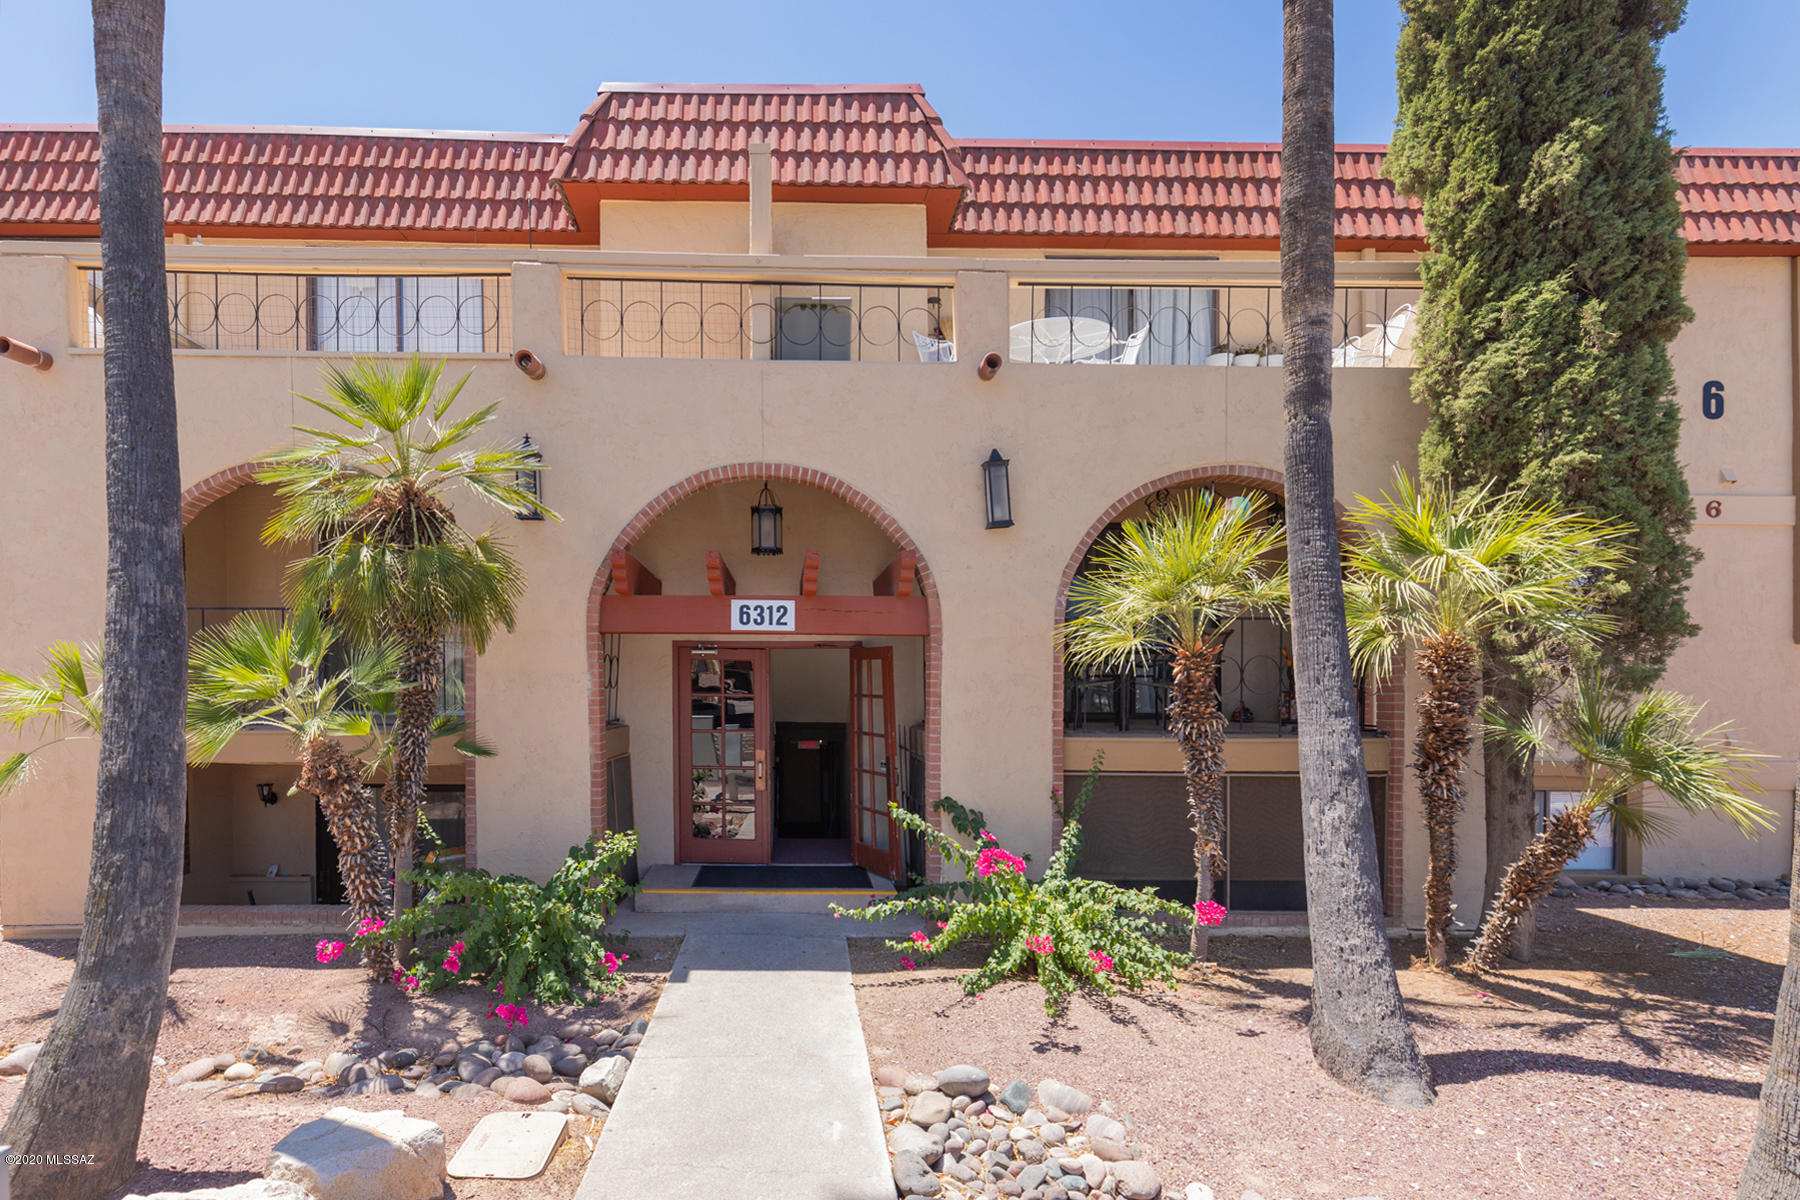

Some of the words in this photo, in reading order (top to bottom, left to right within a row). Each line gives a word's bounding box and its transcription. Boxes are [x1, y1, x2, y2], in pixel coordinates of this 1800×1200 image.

[1702, 380, 1725, 420] 6
[1705, 500, 1722, 518] 6
[739, 604, 788, 626] 6312
